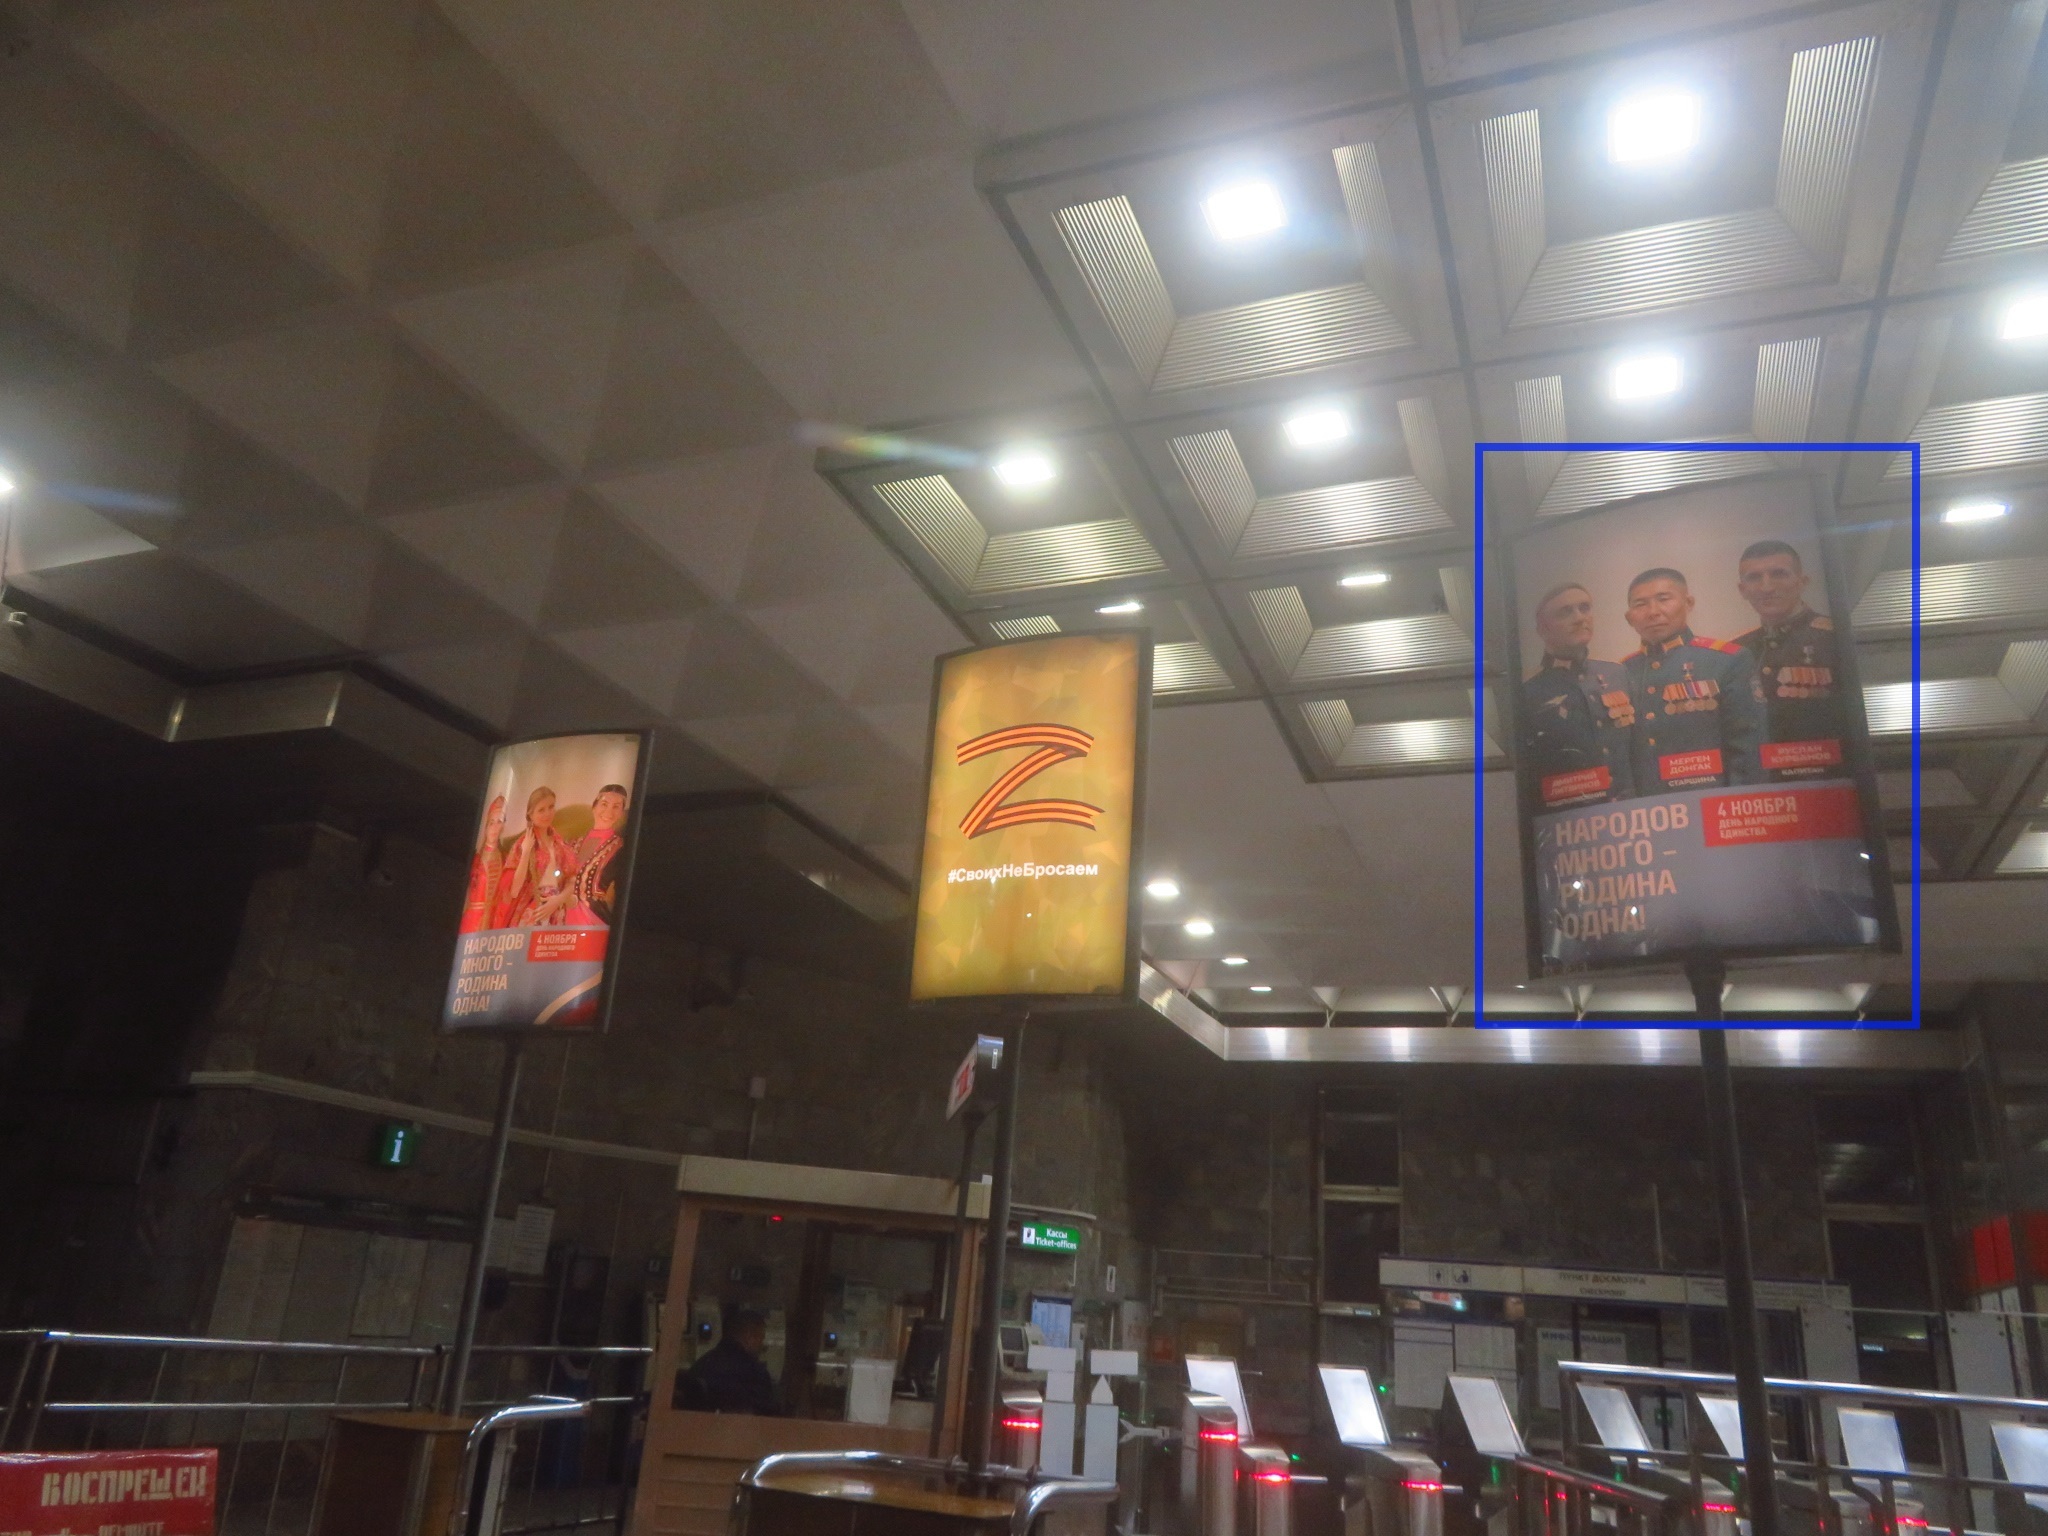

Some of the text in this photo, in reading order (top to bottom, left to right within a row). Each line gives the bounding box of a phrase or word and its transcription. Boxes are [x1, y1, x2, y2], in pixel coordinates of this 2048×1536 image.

[1668, 754, 1711, 766] МЕРГЕН
[1669, 763, 1712, 775] ДОНГАК
[956, 722, 1106, 840] Z
[1667, 775, 1717, 788] СТАРШИНА
[1717, 795, 1797, 818] 4 НОЯБРЯ
[1555, 803, 1690, 848] НАРОДОВ
[1718, 813, 1799, 830] ДЕНЬ НАРОДНОГО
[1719, 826, 1768, 840] ЕДИНСТВА
[1557, 838, 1654, 877] МНОГО
[947, 861, 1099, 884] #СвоихНеБросаем
[1560, 868, 1678, 908] РОДИНА
[1562, 905, 1646, 941] ОДНА!
[464, 934, 524, 954] НАРОДОВ
[537, 934, 577, 944] 4 НОЯБРЯ
[461, 955, 503, 974] МНОГО
[456, 975, 507, 995] РОДИНА
[453, 997, 490, 1015] ОДНА!
[1046, 1227, 1068, 1239] Кассы
[1036, 1237, 1077, 1250] Ticket-offices
